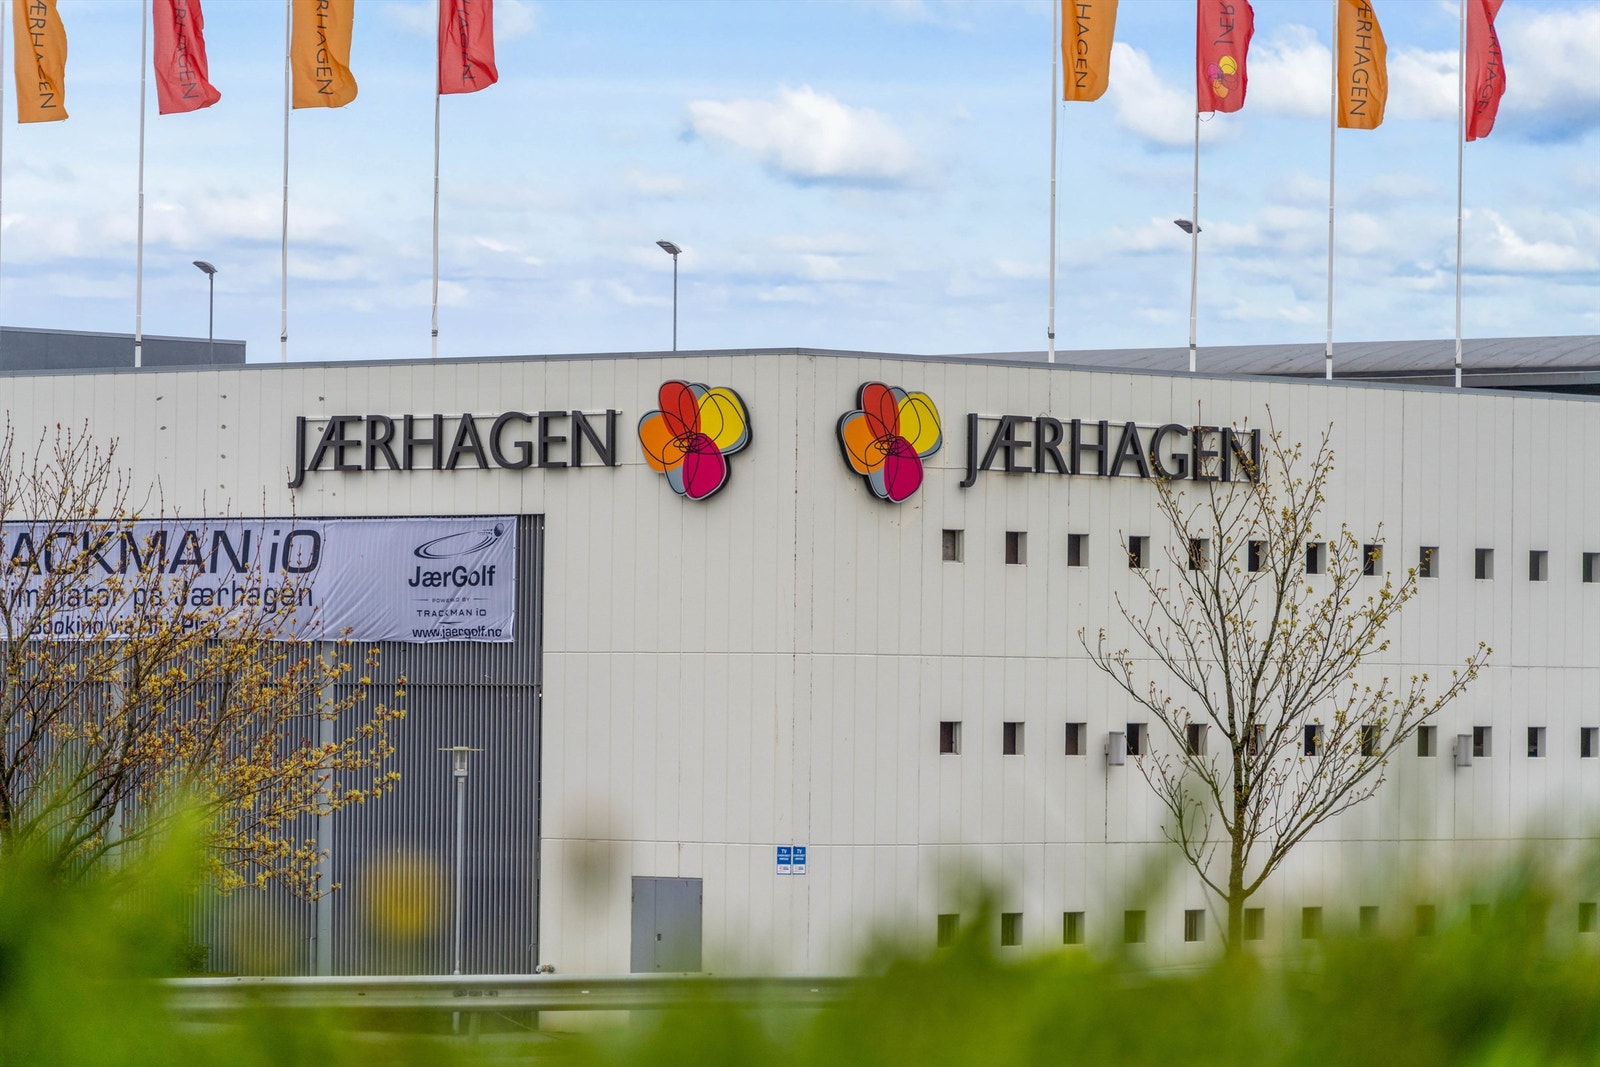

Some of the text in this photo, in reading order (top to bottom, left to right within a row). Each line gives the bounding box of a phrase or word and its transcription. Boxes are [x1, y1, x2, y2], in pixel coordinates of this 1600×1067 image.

[288, 408, 617, 488] JÆRHAGEN
[959, 412, 1262, 488] JÆRHAGEN
[408, 565, 496, 588] JærGolf
[416, 609, 473, 617] TRACKMAN
[412, 625, 502, 639] www.jaergolf.no
